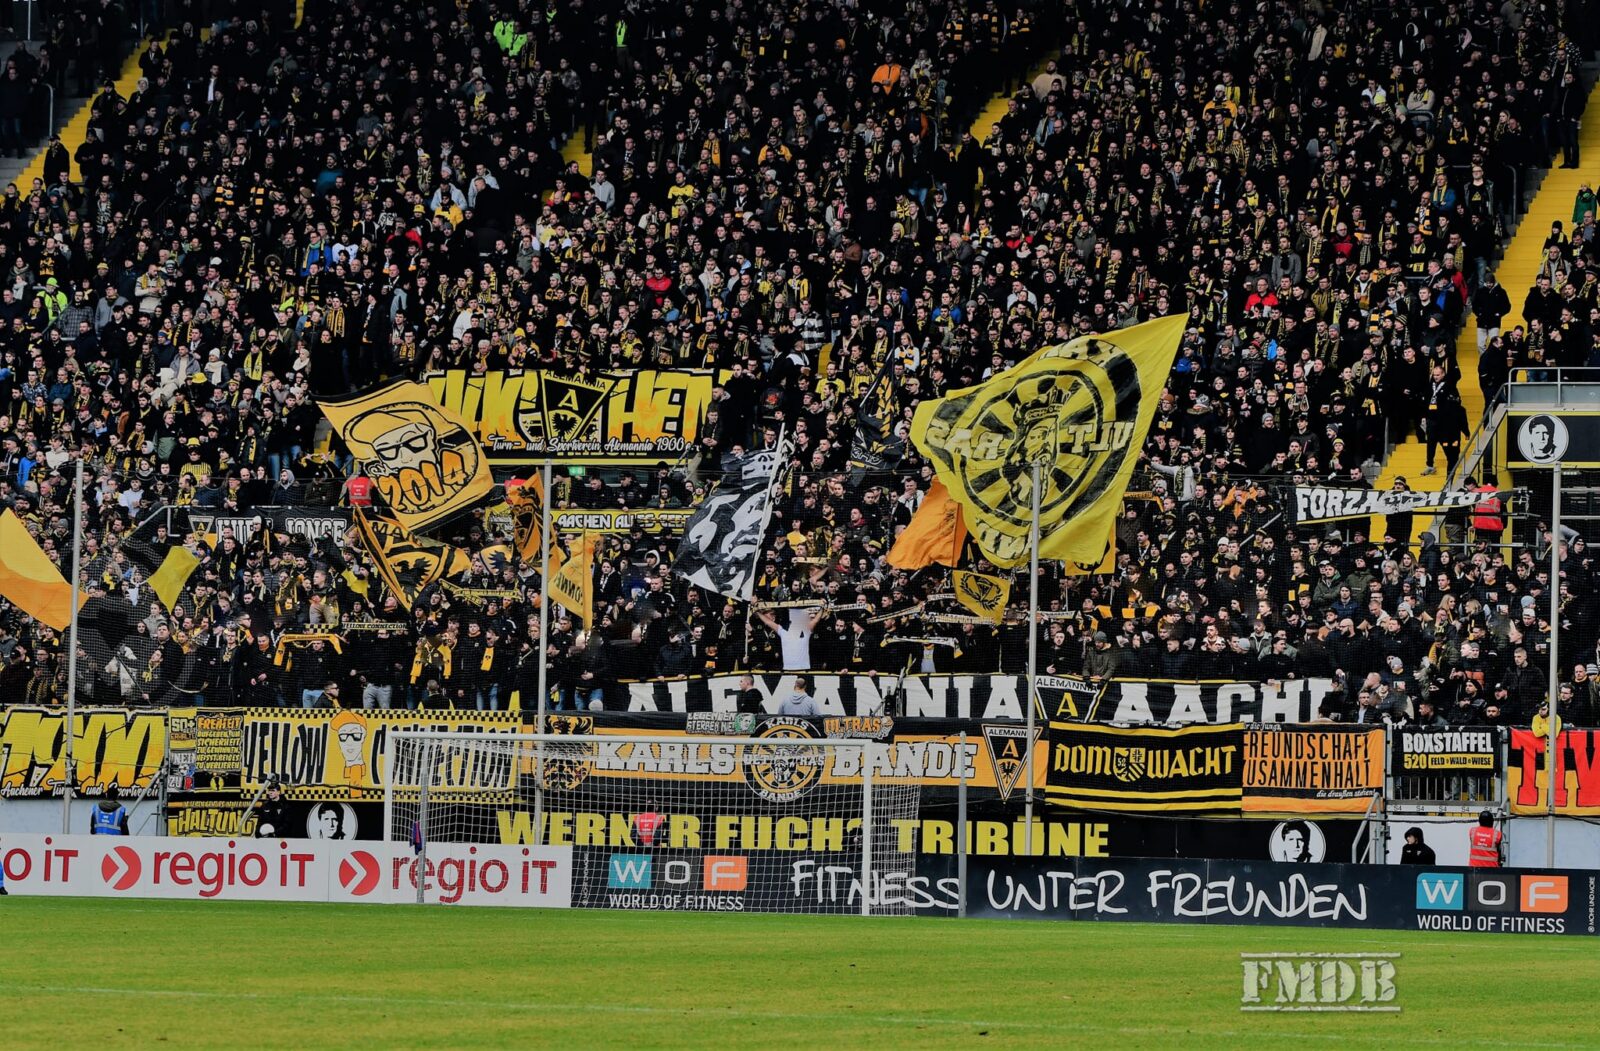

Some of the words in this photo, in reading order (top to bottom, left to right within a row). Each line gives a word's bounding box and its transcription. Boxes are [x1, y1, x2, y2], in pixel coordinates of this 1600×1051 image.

[558, 388, 580, 411] A
[377, 449, 469, 512] 2014
[557, 513, 612, 530] AACHEN
[1056, 691, 1079, 718] A
[988, 728, 1028, 738] ALEMANN
[1402, 732, 1494, 753] BOXSTAFFEL
[243, 721, 329, 785] YELLOW
[594, 741, 737, 776] KARLS
[1001, 739, 1019, 758] A
[1146, 746, 1237, 780] WACHT
[1403, 753, 1427, 770] 520
[1430, 756, 1446, 766] FELD
[1449, 756, 1468, 766] WALD
[1471, 756, 1492, 766] WIESE
[153, 840, 268, 897] regio
[280, 841, 315, 887] iT
[393, 846, 509, 903] regio
[609, 894, 660, 909] WORLD
[663, 895, 681, 909] OF
[685, 895, 744, 911] FITNESS
[791, 860, 962, 911] FITNESS
[986, 869, 1128, 914] UNTER
[1147, 870, 1368, 921] FREUNDEN
[1417, 914, 1472, 931] WORLD
[1477, 916, 1497, 932] OF
[1501, 917, 1565, 934] FITNESS
